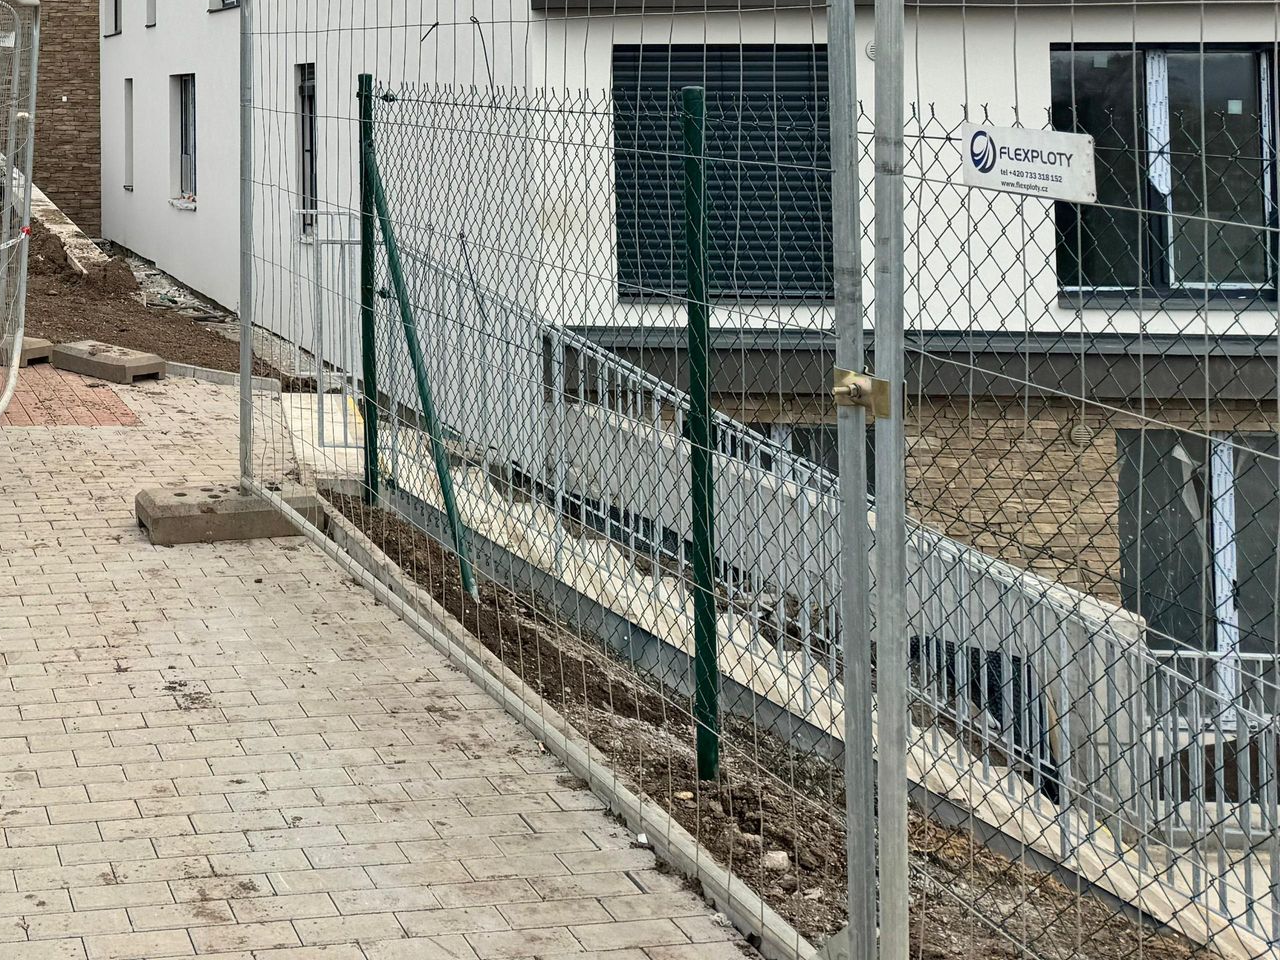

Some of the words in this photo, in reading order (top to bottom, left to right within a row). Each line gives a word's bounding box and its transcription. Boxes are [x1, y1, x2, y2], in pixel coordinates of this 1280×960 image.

[999, 146, 1073, 167] FLEXPLOTY
[1009, 170, 1024, 178] +420
[1025, 171, 1037, 179] 733
[1038, 173, 1050, 181] 318
[1051, 175, 1063, 183] 152
[1000, 180, 1048, 192] www.flexploty.cz
